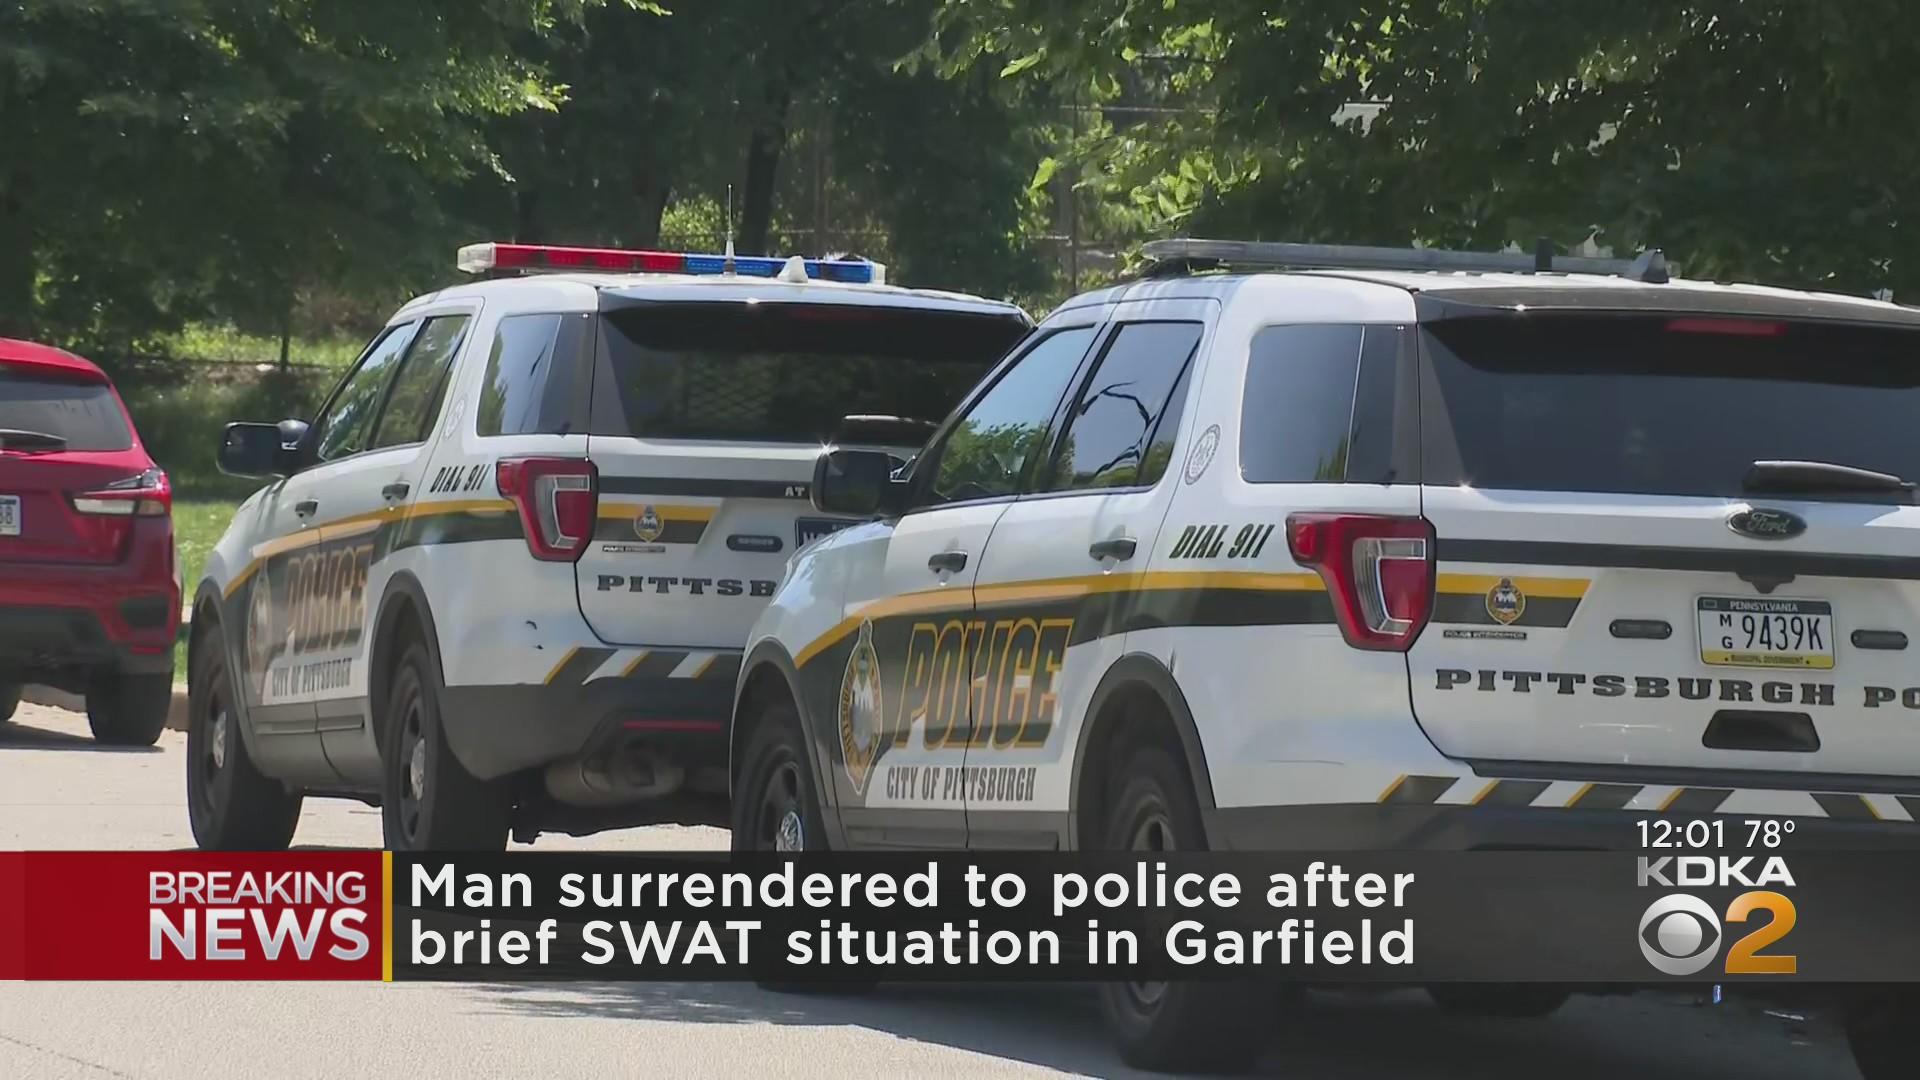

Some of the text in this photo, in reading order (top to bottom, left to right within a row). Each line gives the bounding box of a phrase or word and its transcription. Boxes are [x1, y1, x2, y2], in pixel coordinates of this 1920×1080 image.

[430, 463, 491, 493] DIAL 911
[1747, 511, 1791, 534] Ford
[1169, 523, 1276, 559] DIAL 911
[286, 544, 375, 656] POLICE
[1729, 600, 1799, 613] PENNSYLVANIA
[1742, 615, 1824, 651] 9439K
[894, 617, 1075, 750] POLICE
[1434, 668, 1836, 707] PITTSBURGH
[886, 766, 1037, 802] CITY OF PITTSBURGH
